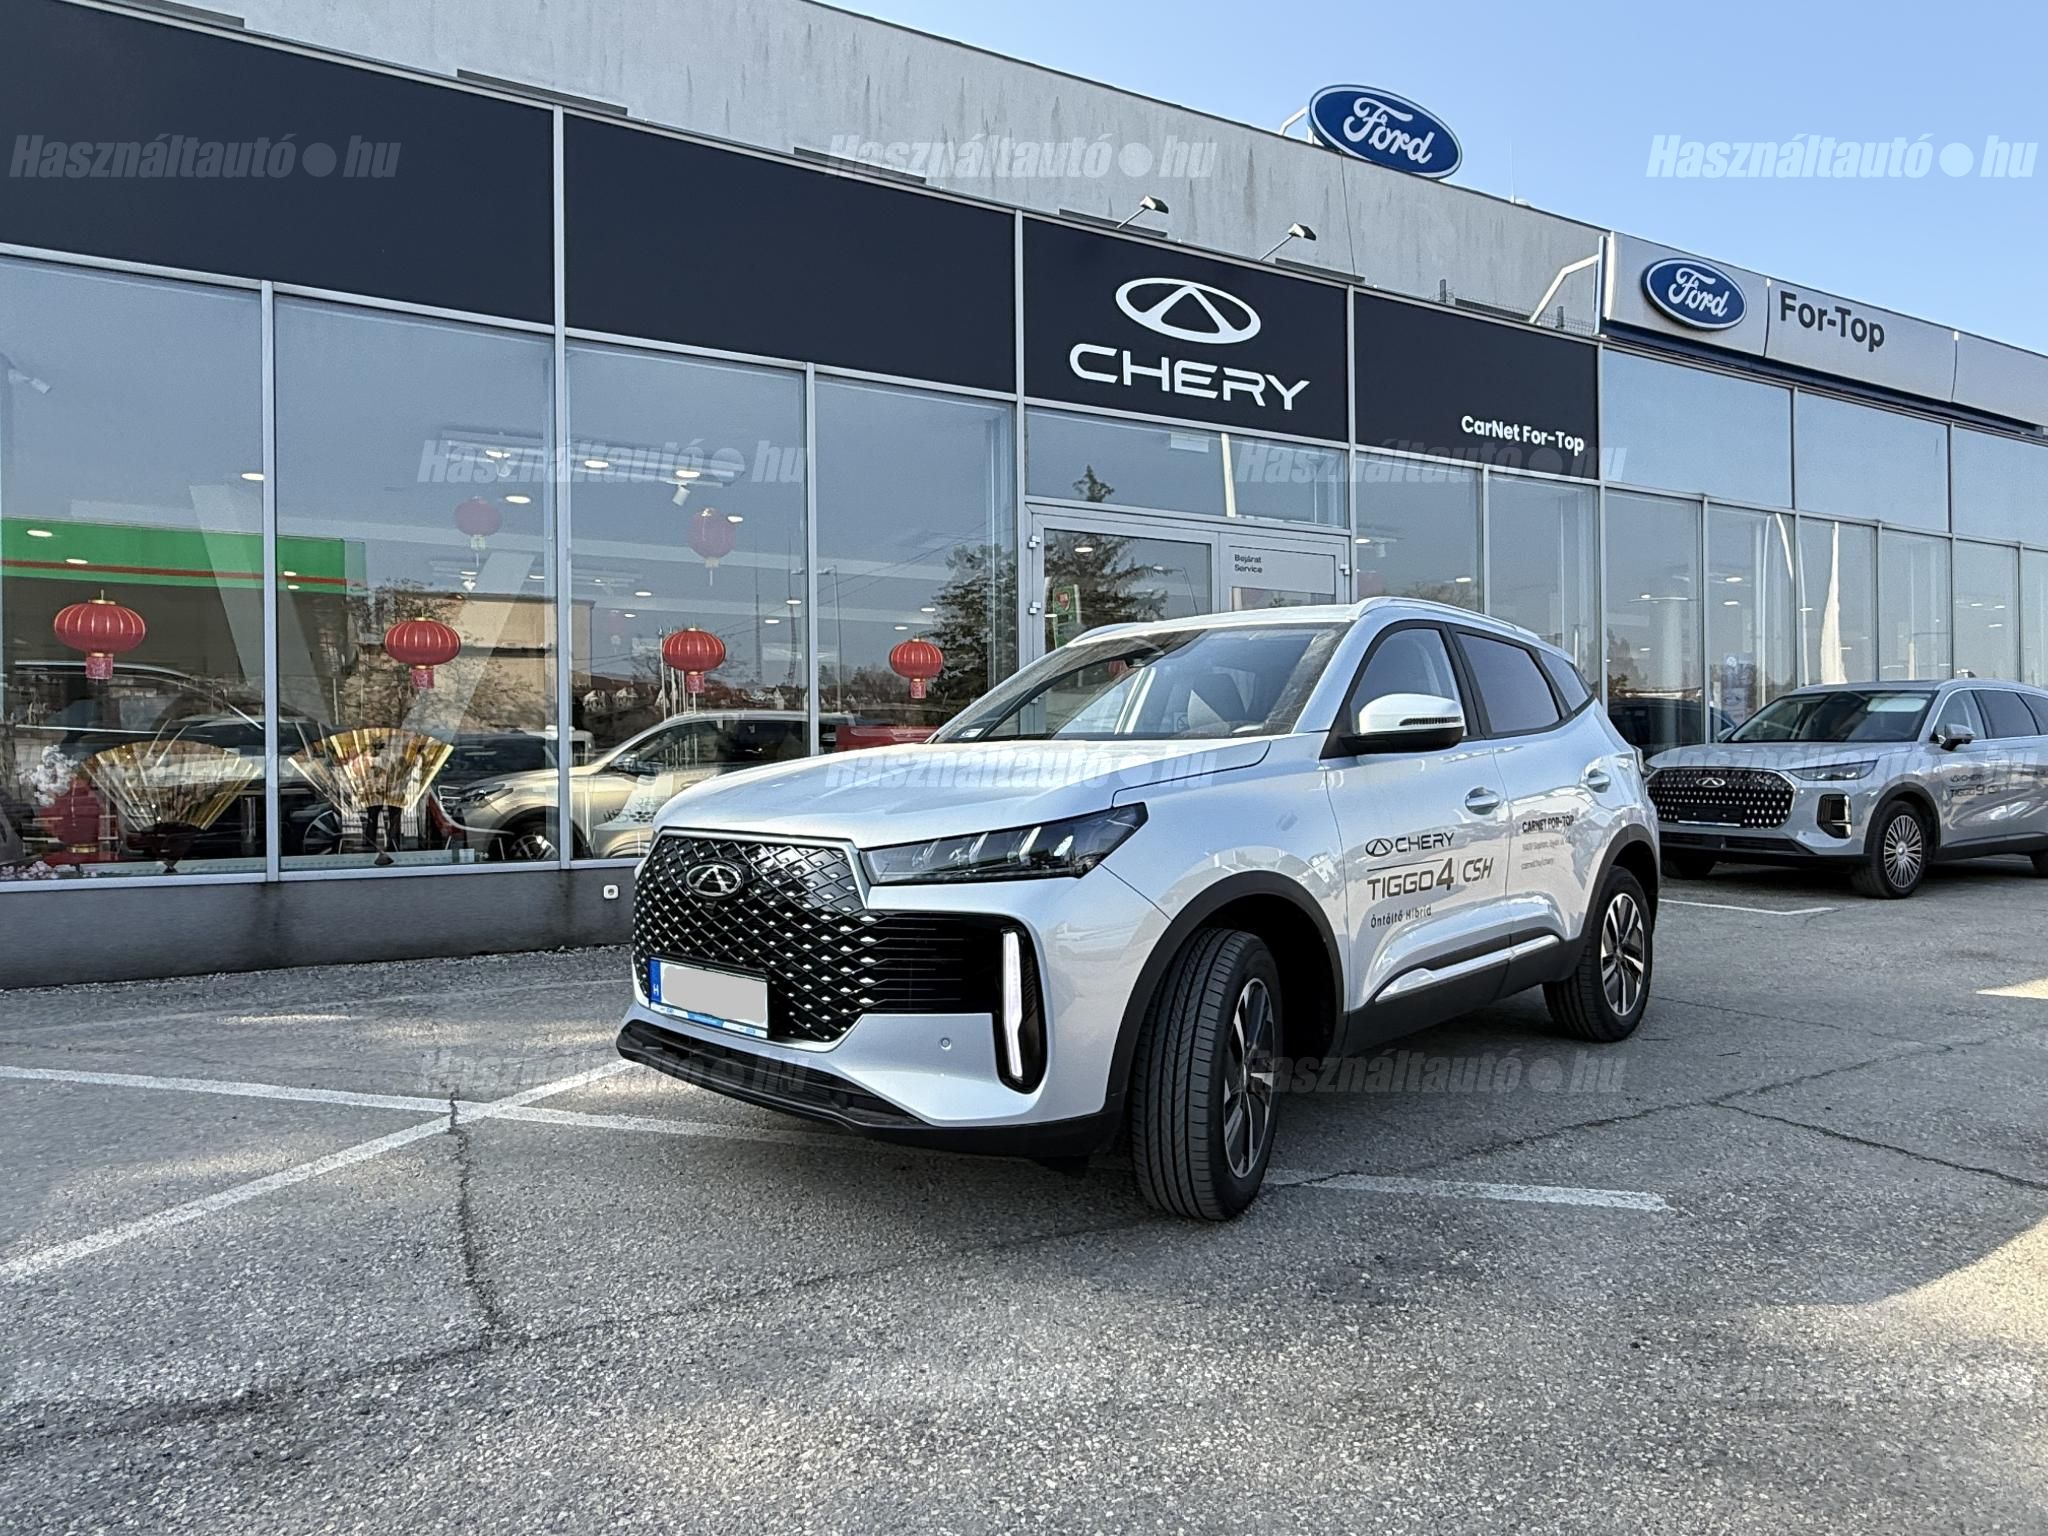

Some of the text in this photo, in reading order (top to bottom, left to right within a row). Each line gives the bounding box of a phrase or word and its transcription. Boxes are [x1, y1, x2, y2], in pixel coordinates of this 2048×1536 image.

[1343, 97, 1434, 165] Ford
[1667, 267, 1733, 318] Ford
[1780, 291, 1885, 352] For-Top
[1069, 343, 1311, 411] CHERY
[1461, 415, 1584, 456] CarNet For-Top
[1234, 564, 1263, 573] Service
[1395, 832, 1454, 852] CHERY
[1463, 857, 1494, 882] CSH
